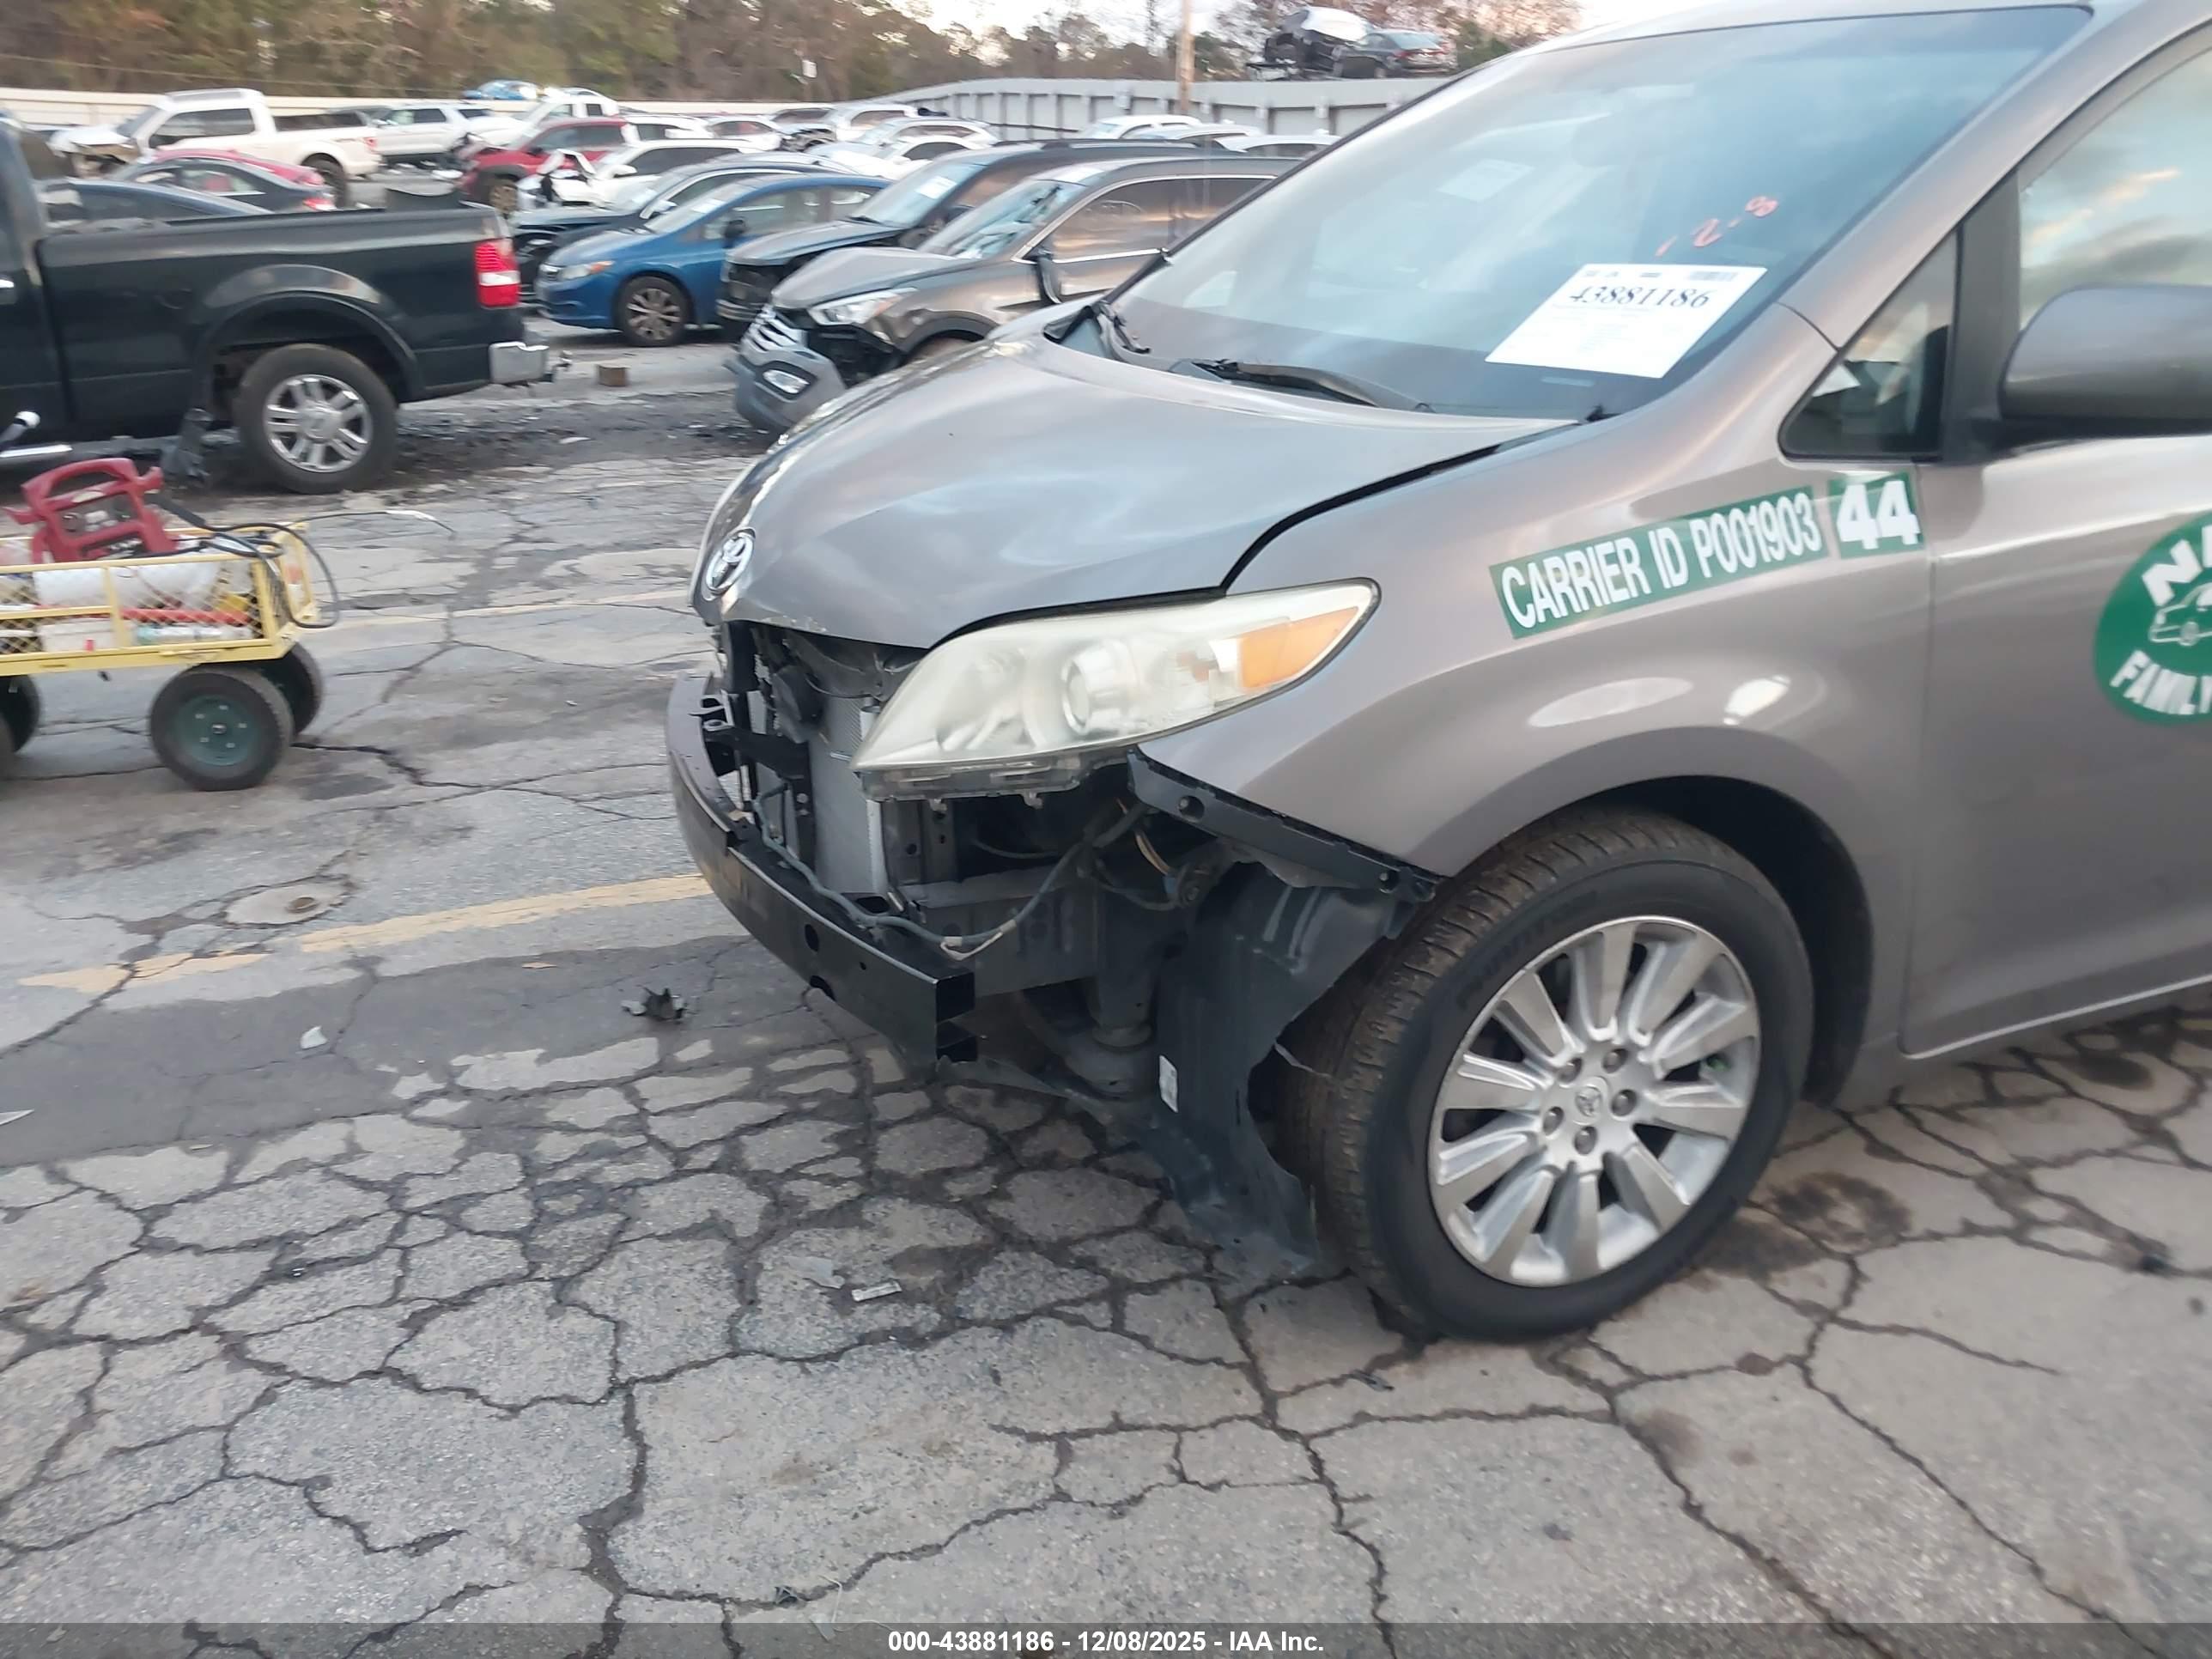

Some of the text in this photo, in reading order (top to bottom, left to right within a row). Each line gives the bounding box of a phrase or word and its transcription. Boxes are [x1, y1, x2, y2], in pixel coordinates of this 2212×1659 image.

[1568, 284, 1715, 309] 43881186
[1835, 479, 1922, 550] 44
[1500, 491, 1822, 629] CARRIER ID P001903
